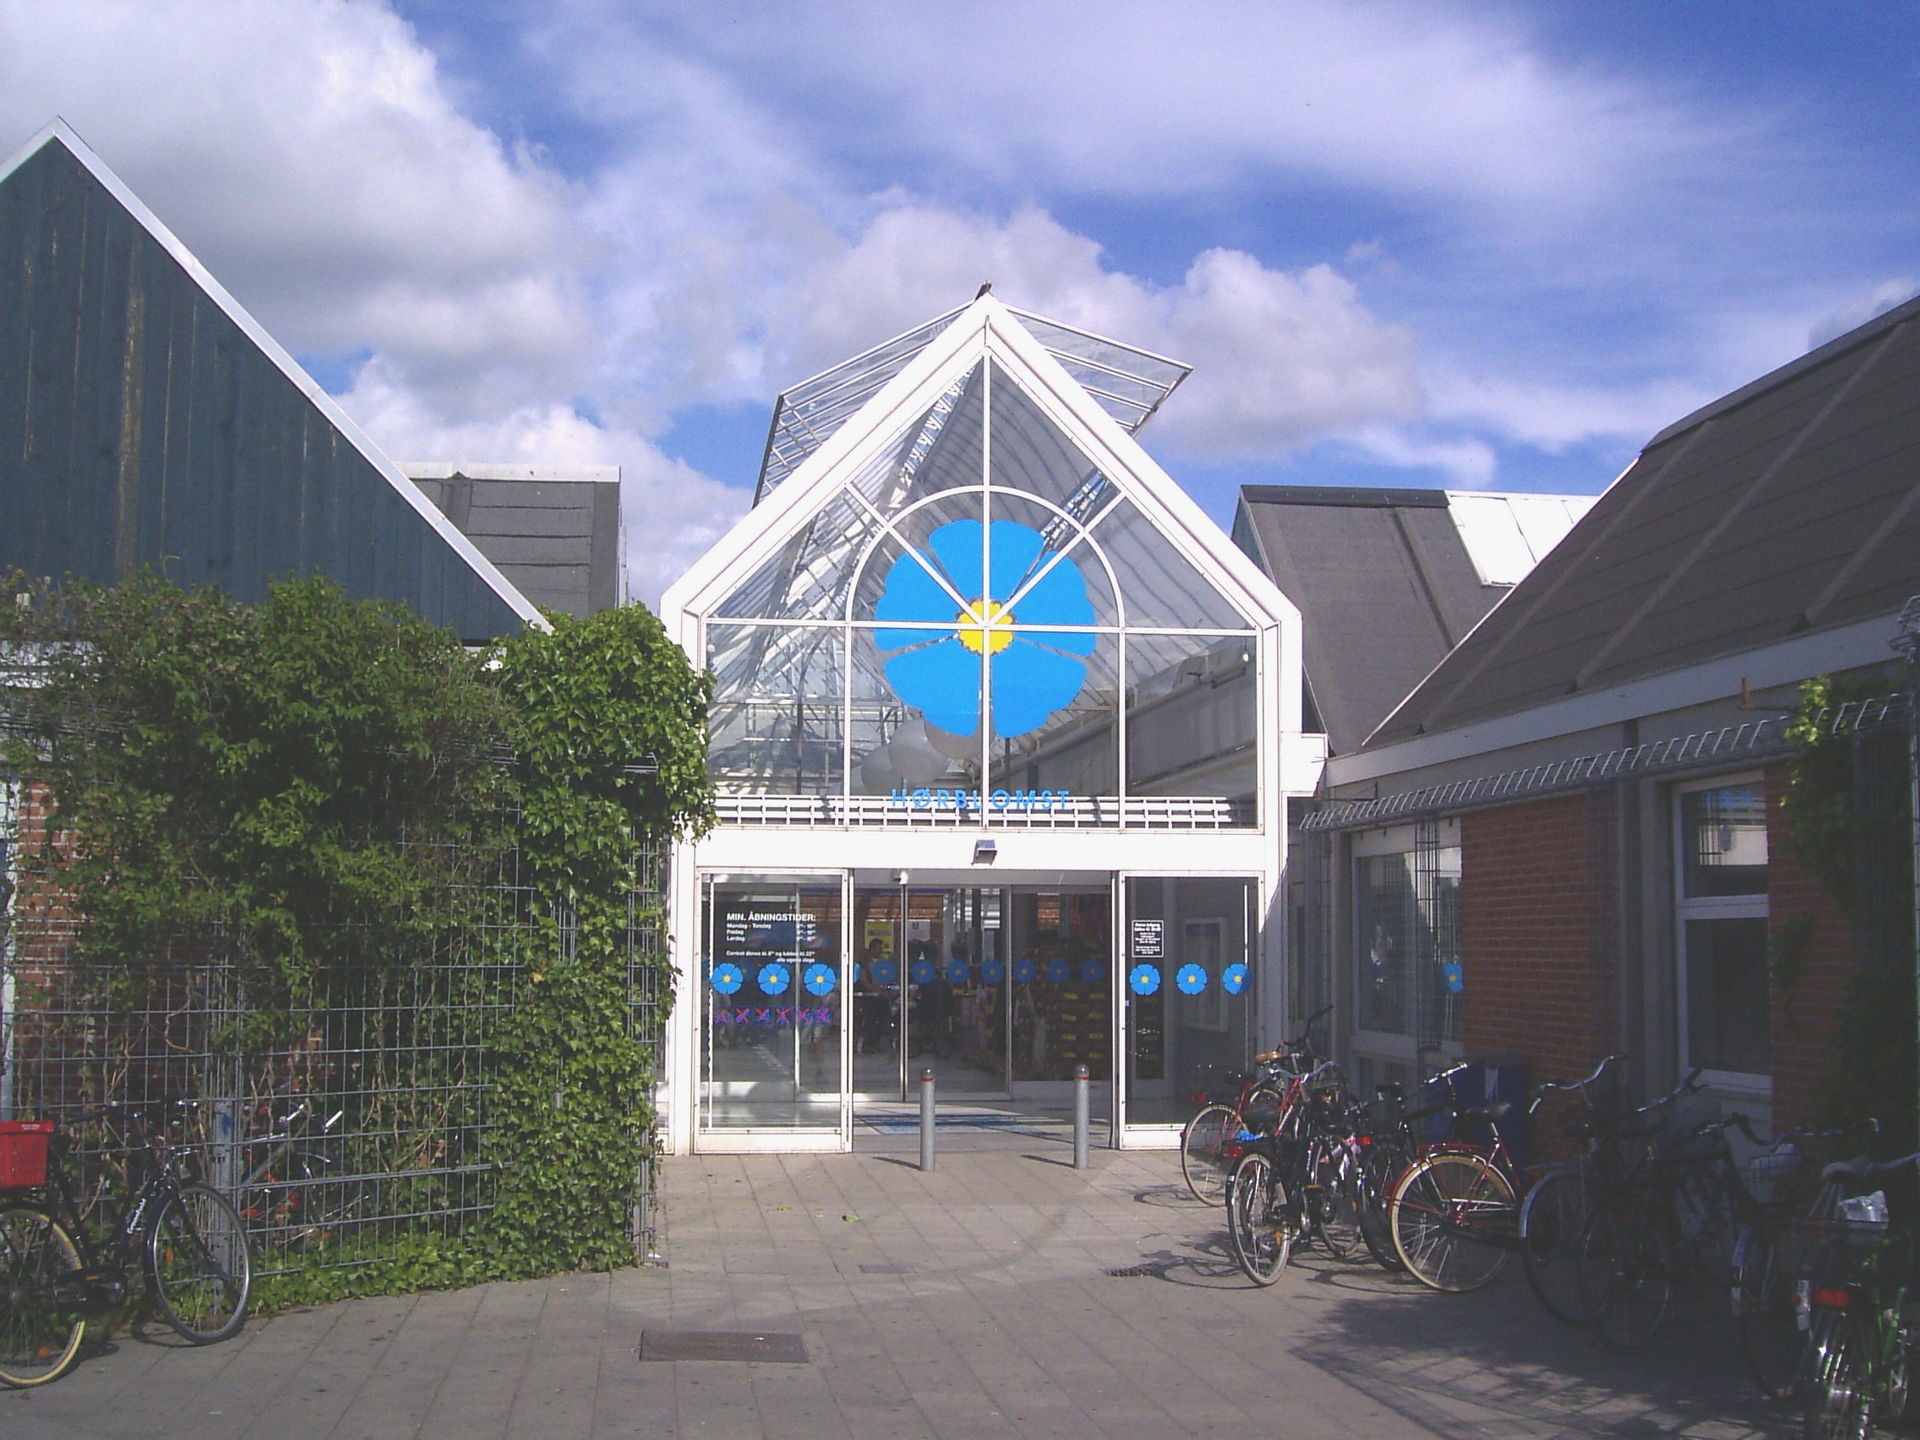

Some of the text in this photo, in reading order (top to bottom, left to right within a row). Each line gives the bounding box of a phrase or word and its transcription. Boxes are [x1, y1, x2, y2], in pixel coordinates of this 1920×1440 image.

[891, 788, 1069, 810] HØRBLOMST
[726, 911, 816, 921] MIN. ÅBNINGSTIDER:
